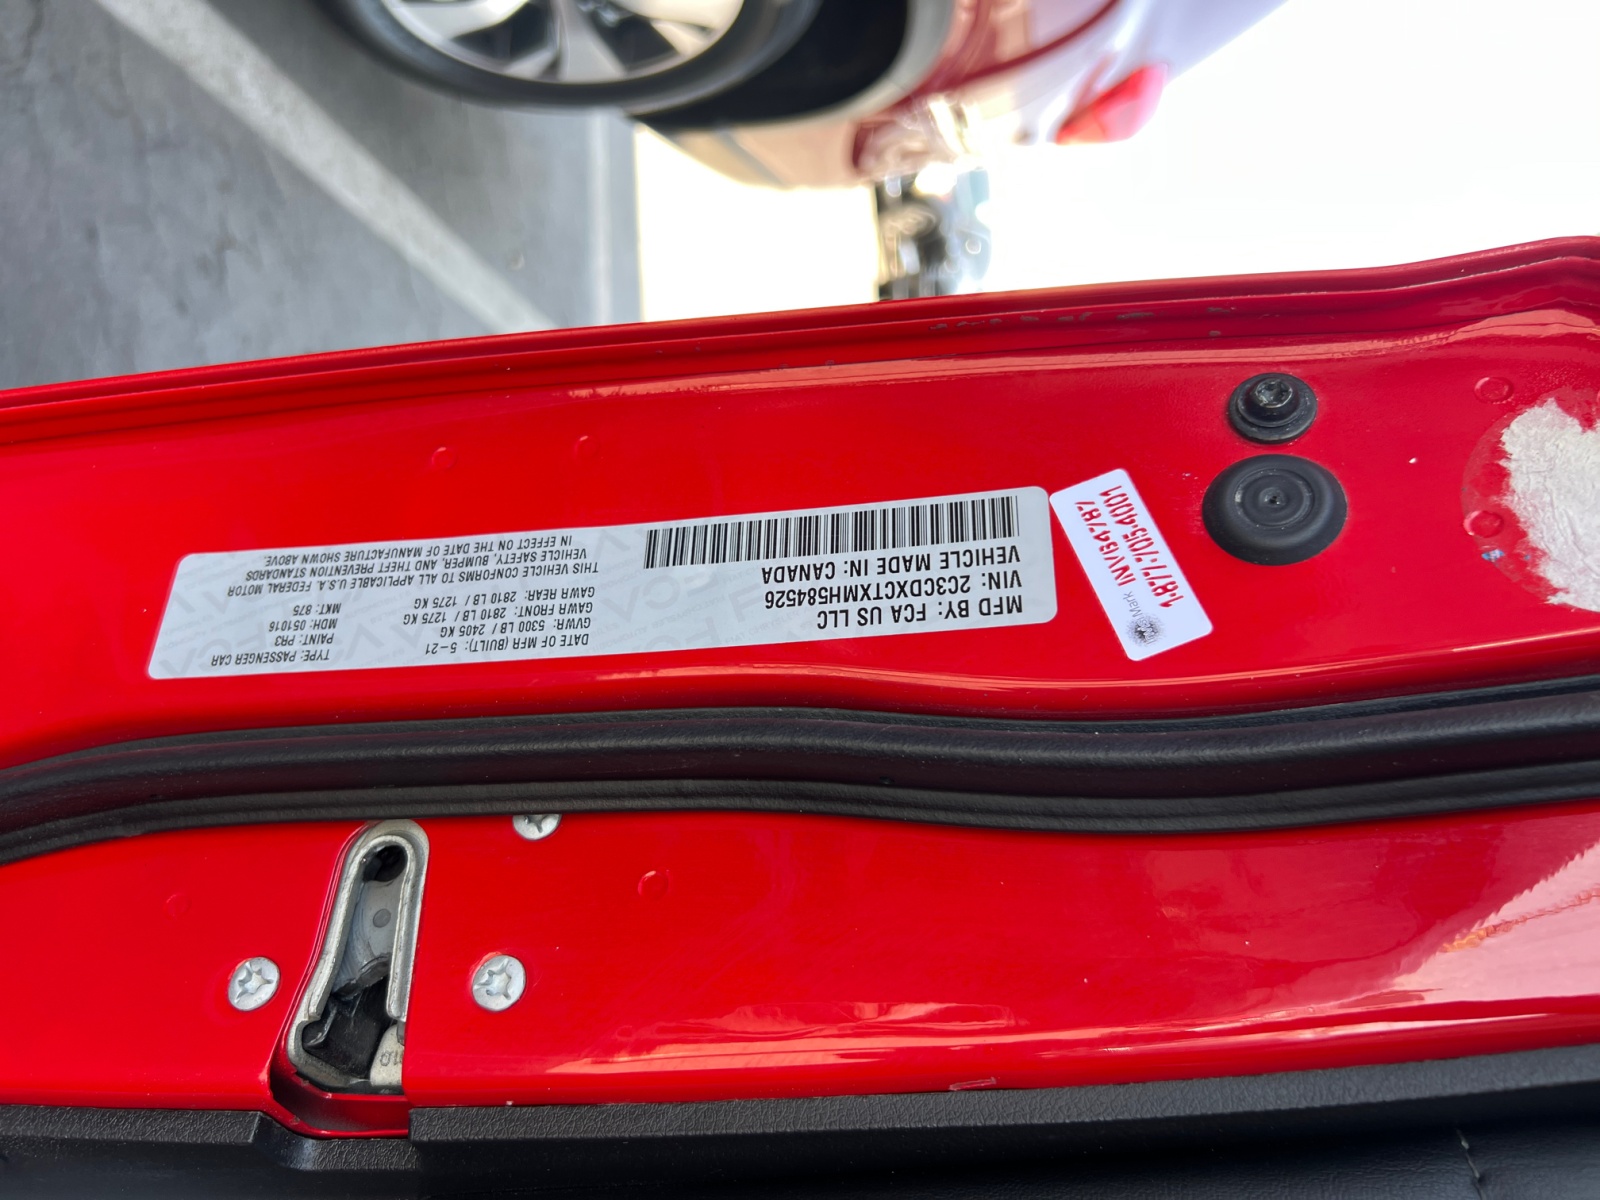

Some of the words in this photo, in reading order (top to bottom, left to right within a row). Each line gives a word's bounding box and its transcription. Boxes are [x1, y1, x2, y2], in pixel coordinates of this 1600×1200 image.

[473, 541, 494, 553] THE
[497, 539, 514, 551] ON
[516, 535, 557, 550] EFFECT
[560, 535, 572, 547] IN
[343, 546, 423, 562] MANUFACTURE
[425, 545, 440, 557] OF
[442, 542, 470, 556] DATE
[540, 547, 587, 562] VEHICLE
[264, 554, 299, 567] ABOVE.
[301, 551, 341, 564] SHOWN
[442, 554, 489, 569] BUMPER,
[493, 551, 538, 565] SAFETY,
[876, 553, 931, 575] MADE
[939, 544, 1021, 570] VEHICLE
[309, 562, 375, 577] PREVENTION
[377, 560, 411, 573] THEFT
[414, 559, 438, 571] AND
[522, 563, 569, 578] VEHICLE
[572, 561, 598, 574] THIS
[843, 558, 868, 578] IN:
[245, 567, 307, 582] STANDARDS
[418, 573, 438, 585] ALL
[441, 572, 454, 584] TO
[458, 566, 519, 583] CONFORMS
[761, 561, 836, 585] CANADA
[981, 569, 1022, 591] VIN:
[267, 580, 312, 593] FEDERAL
[317, 578, 347, 591] U.S.A.
[349, 574, 414, 589] APPLICABLE
[227, 584, 263, 597] MOTOR
[490, 590, 517, 604] 2810
[524, 588, 557, 602] REAR:
[560, 586, 595, 600] GAWR
[764, 574, 971, 609] 2C3CDXCTXMH584526
[315, 602, 342, 615] MKT:
[413, 597, 429, 609] KG
[432, 595, 457, 609] 1275
[558, 601, 593, 615] GAWR
[978, 594, 1023, 616] MFD
[292, 604, 312, 616] 875
[480, 606, 507, 620] 2810
[514, 603, 555, 618] FRONT:
[856, 605, 882, 627] US
[890, 602, 926, 624] FCA
[938, 599, 969, 620] BY:
[309, 617, 338, 630] MDH:
[402, 613, 418, 625] KG
[421, 611, 446, 625] 1275
[553, 616, 591, 631] GVWR:
[816, 608, 849, 630] LLC
[268, 619, 307, 632] 051016
[439, 625, 455, 638] KG
[458, 623, 486, 637] 2405
[518, 619, 545, 633] 5300
[274, 634, 296, 647] PR3
[299, 632, 334, 646] PAINT:
[464, 635, 509, 652] (BUILT):
[512, 636, 538, 650] MFR
[540, 635, 556, 648] OF
[559, 633, 589, 647] DATE
[210, 654, 232, 667] CAR
[234, 650, 297, 665] PASSENGER
[300, 649, 330, 662] TYPE:
